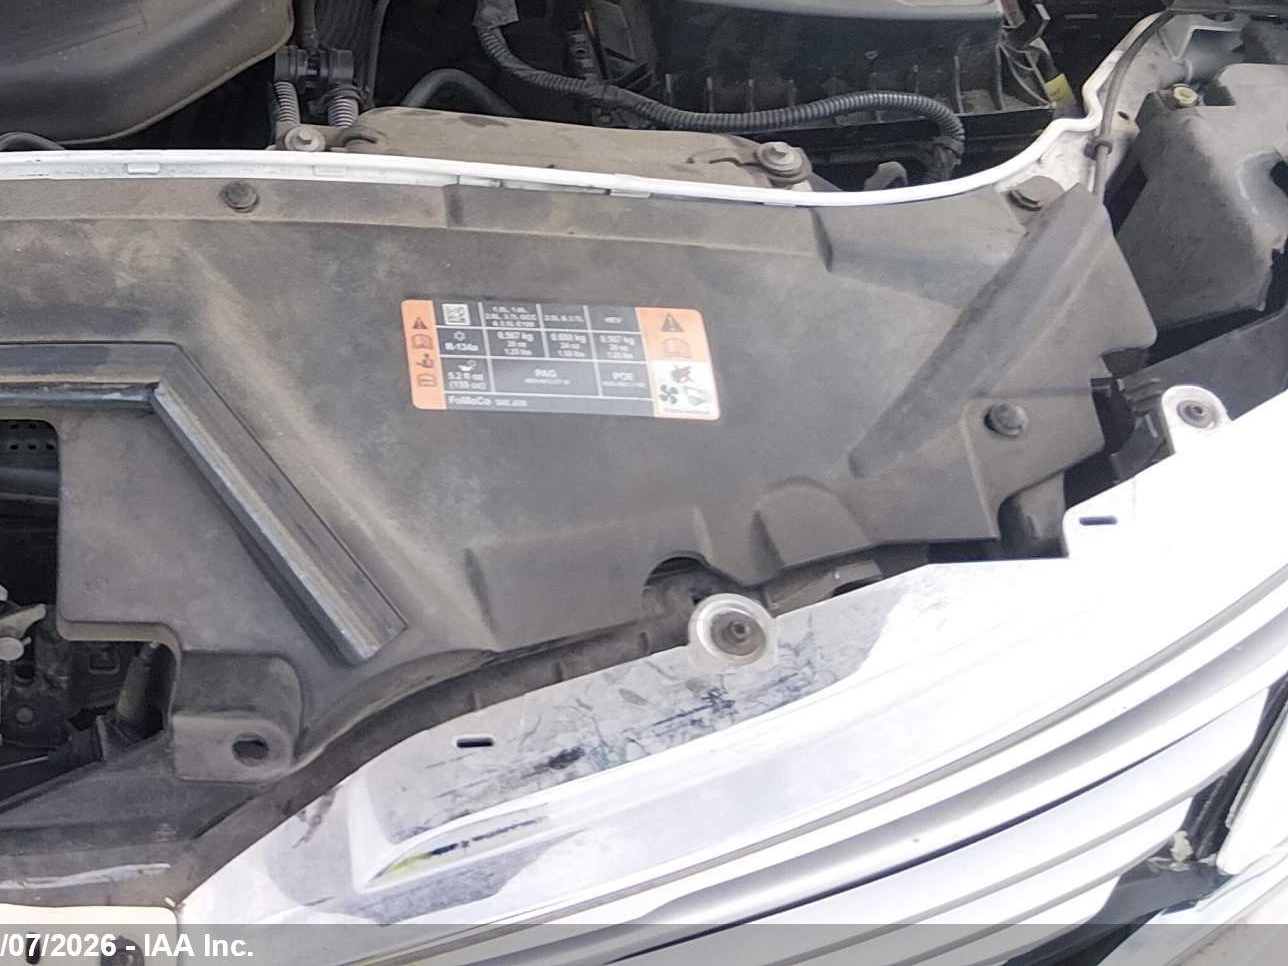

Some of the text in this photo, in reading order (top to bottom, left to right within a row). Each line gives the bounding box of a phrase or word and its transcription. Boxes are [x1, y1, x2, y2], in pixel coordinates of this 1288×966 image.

[445, 342, 479, 351] R-134a
[534, 369, 557, 378] PAG
[448, 395, 491, 406] FoMoCo
